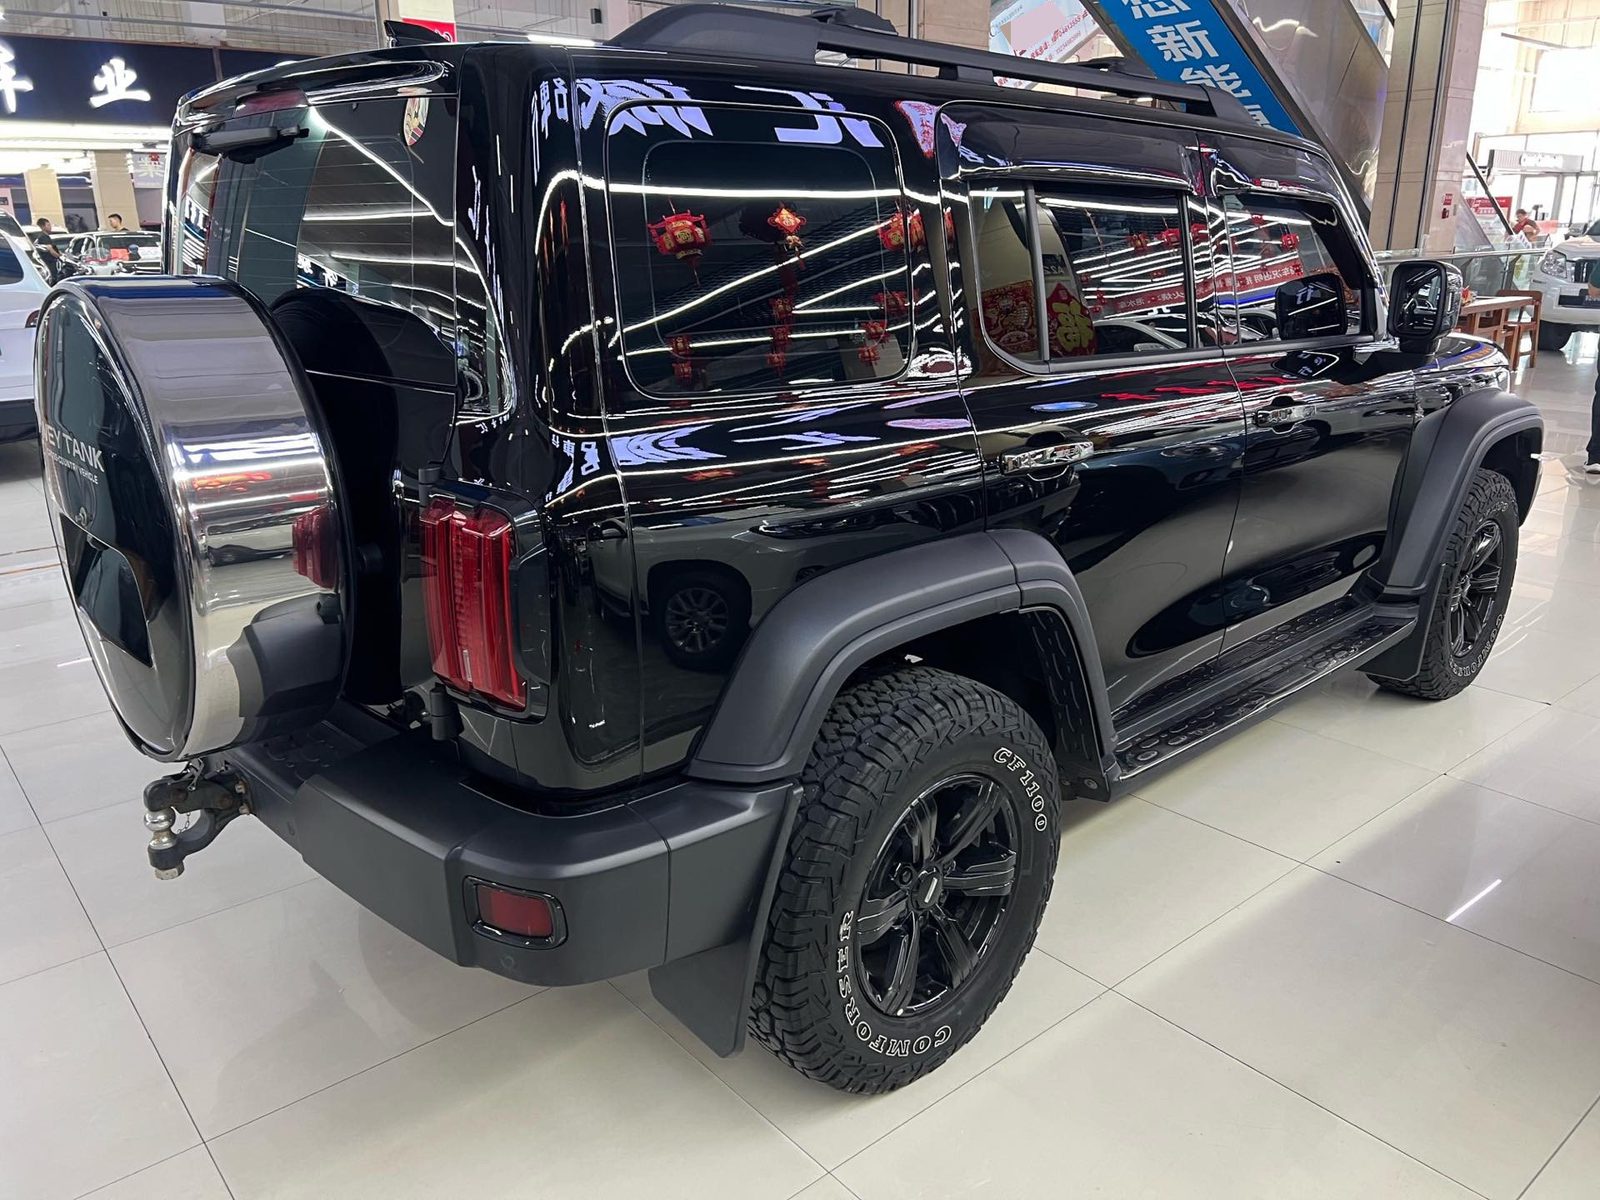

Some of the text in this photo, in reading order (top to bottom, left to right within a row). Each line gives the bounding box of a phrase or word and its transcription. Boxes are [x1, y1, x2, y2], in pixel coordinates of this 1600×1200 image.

[62, 432, 105, 473] TANK
[993, 746, 1048, 832] CF1100
[837, 910, 952, 1057] COMFORSER
